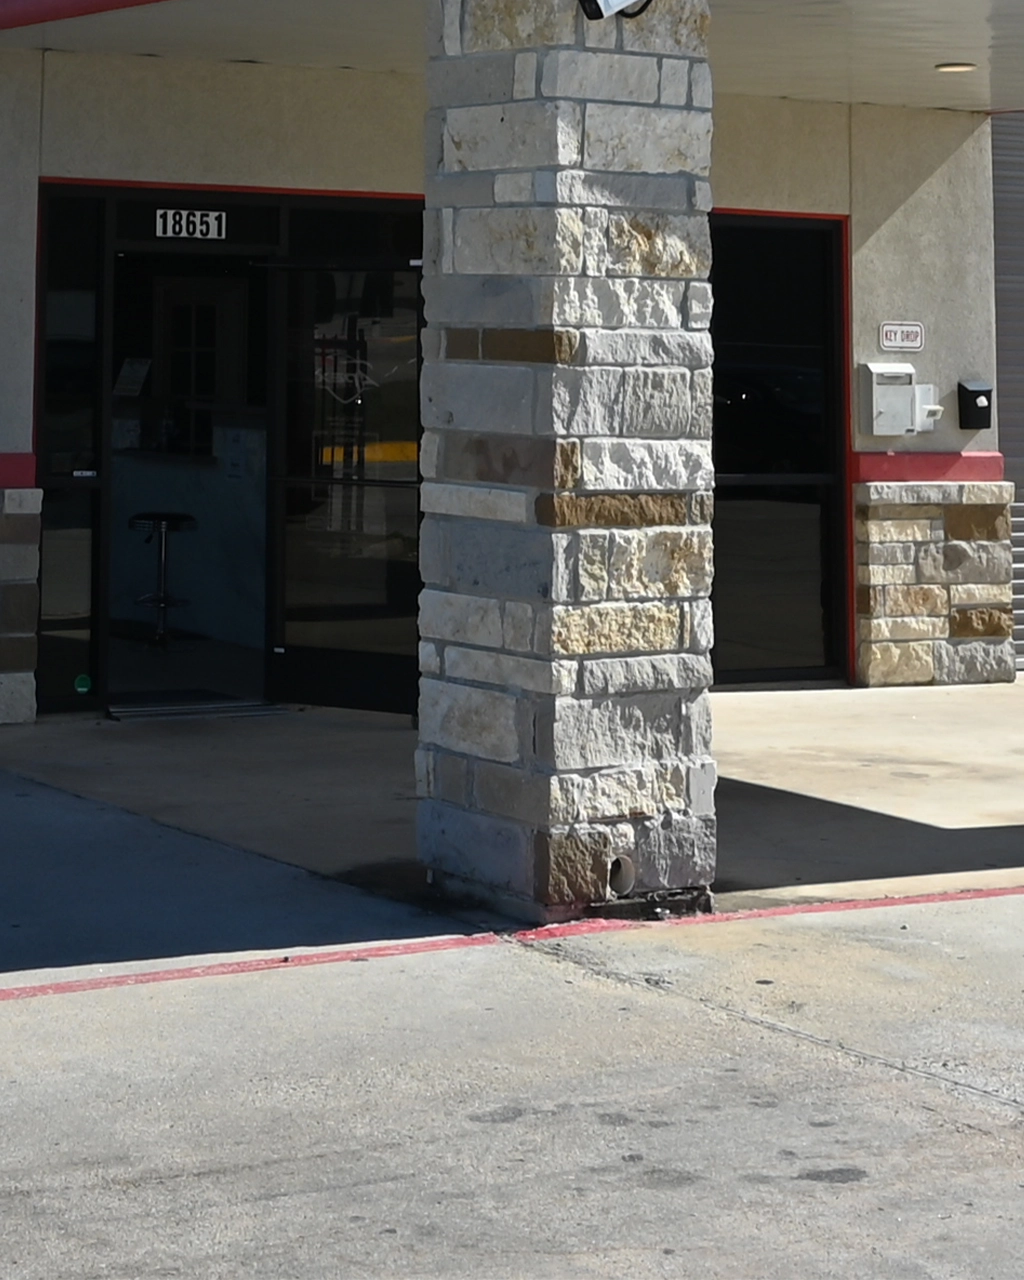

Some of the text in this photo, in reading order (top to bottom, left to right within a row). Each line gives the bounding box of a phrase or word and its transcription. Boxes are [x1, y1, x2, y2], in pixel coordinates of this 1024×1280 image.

[159, 210, 223, 237] 18651
[884, 329, 919, 342] KEY DROP
